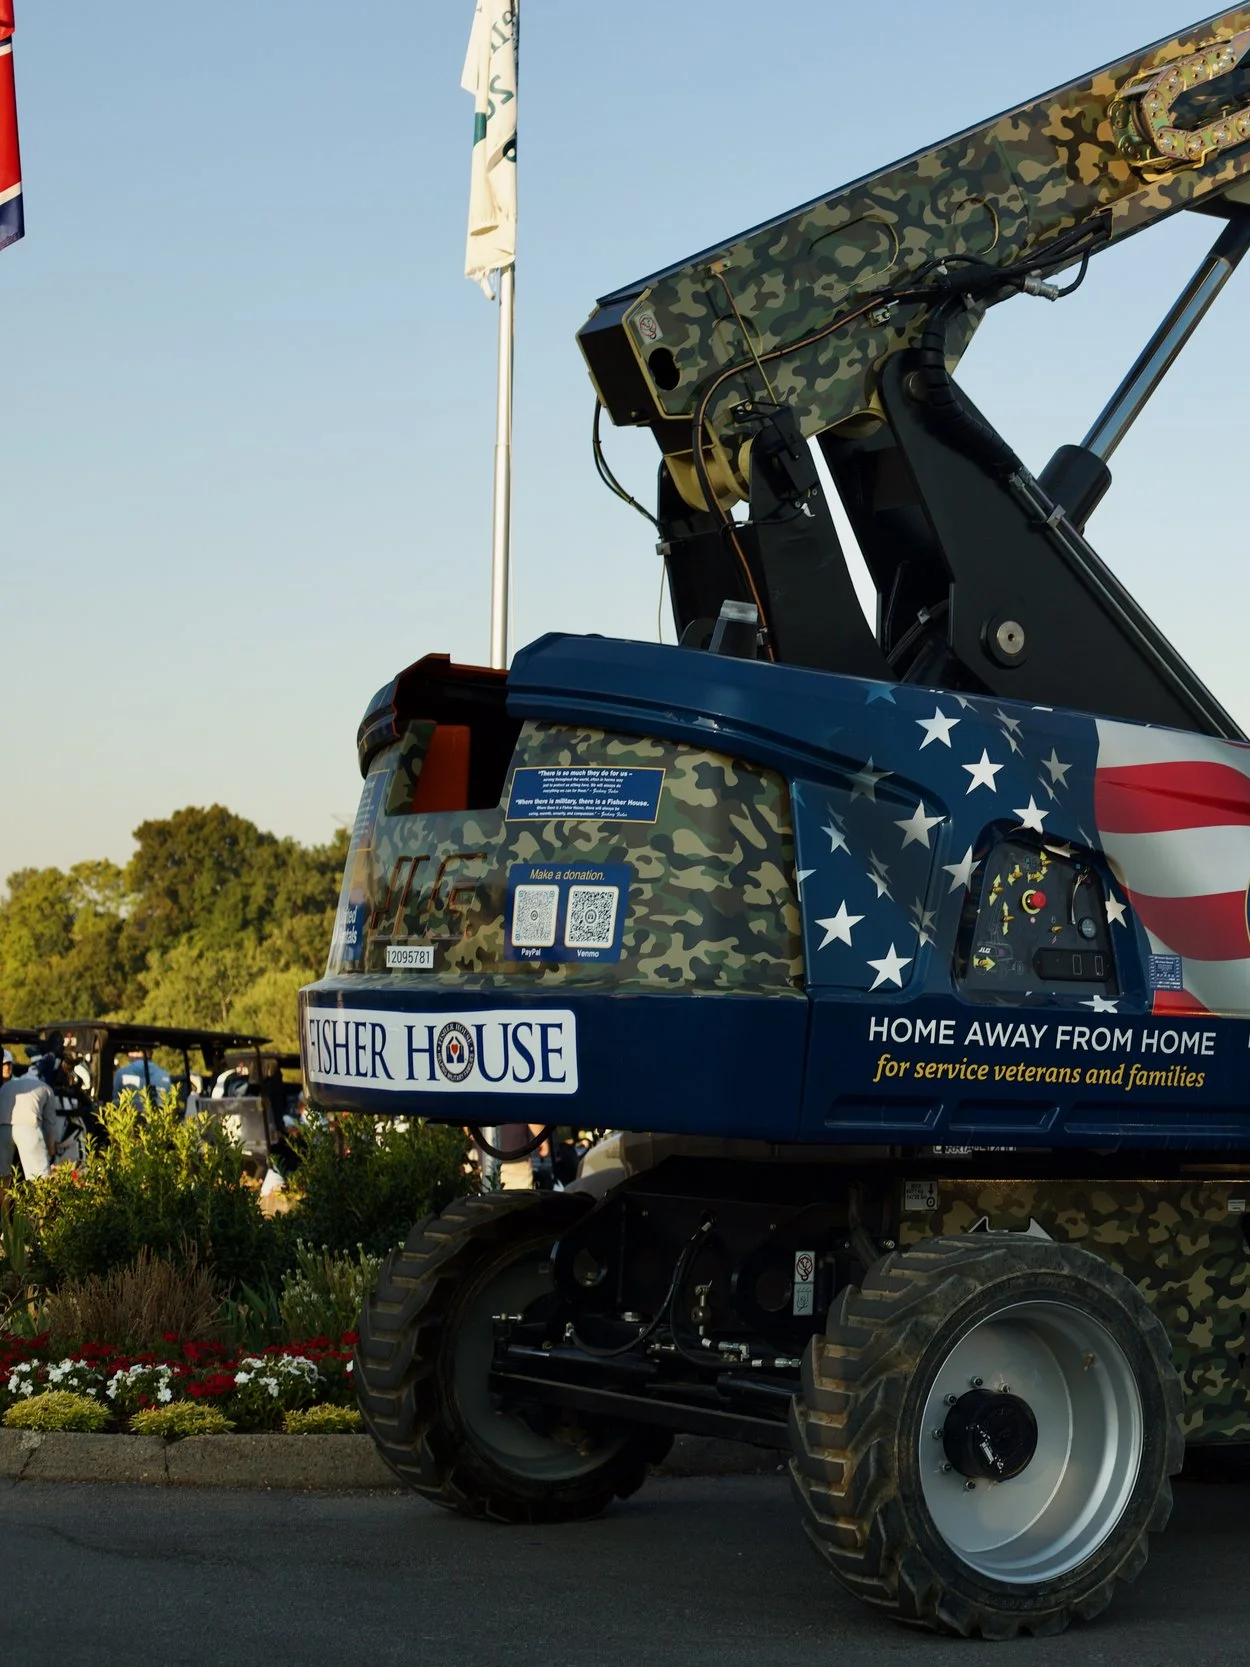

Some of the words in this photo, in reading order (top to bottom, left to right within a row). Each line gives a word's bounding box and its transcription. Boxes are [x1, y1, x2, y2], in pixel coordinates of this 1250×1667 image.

[529, 869, 554, 880] Make
[555, 871, 561, 880] a
[563, 869, 605, 881] donation.
[387, 950, 430, 964] 12095781
[521, 948, 541, 958] PayPal
[577, 949, 600, 958] Venmo
[869, 1016, 956, 1045] HOME
[964, 1021, 1048, 1049] AWAY
[1056, 1025, 1133, 1052] FROM
[1141, 1029, 1217, 1056] HOME
[309, 1018, 395, 1081] FISHER
[872, 1053, 910, 1083] for
[914, 1057, 989, 1081] service
[993, 1062, 1081, 1083] veterans
[1085, 1063, 1125, 1085] and
[1124, 1063, 1206, 1092] families
